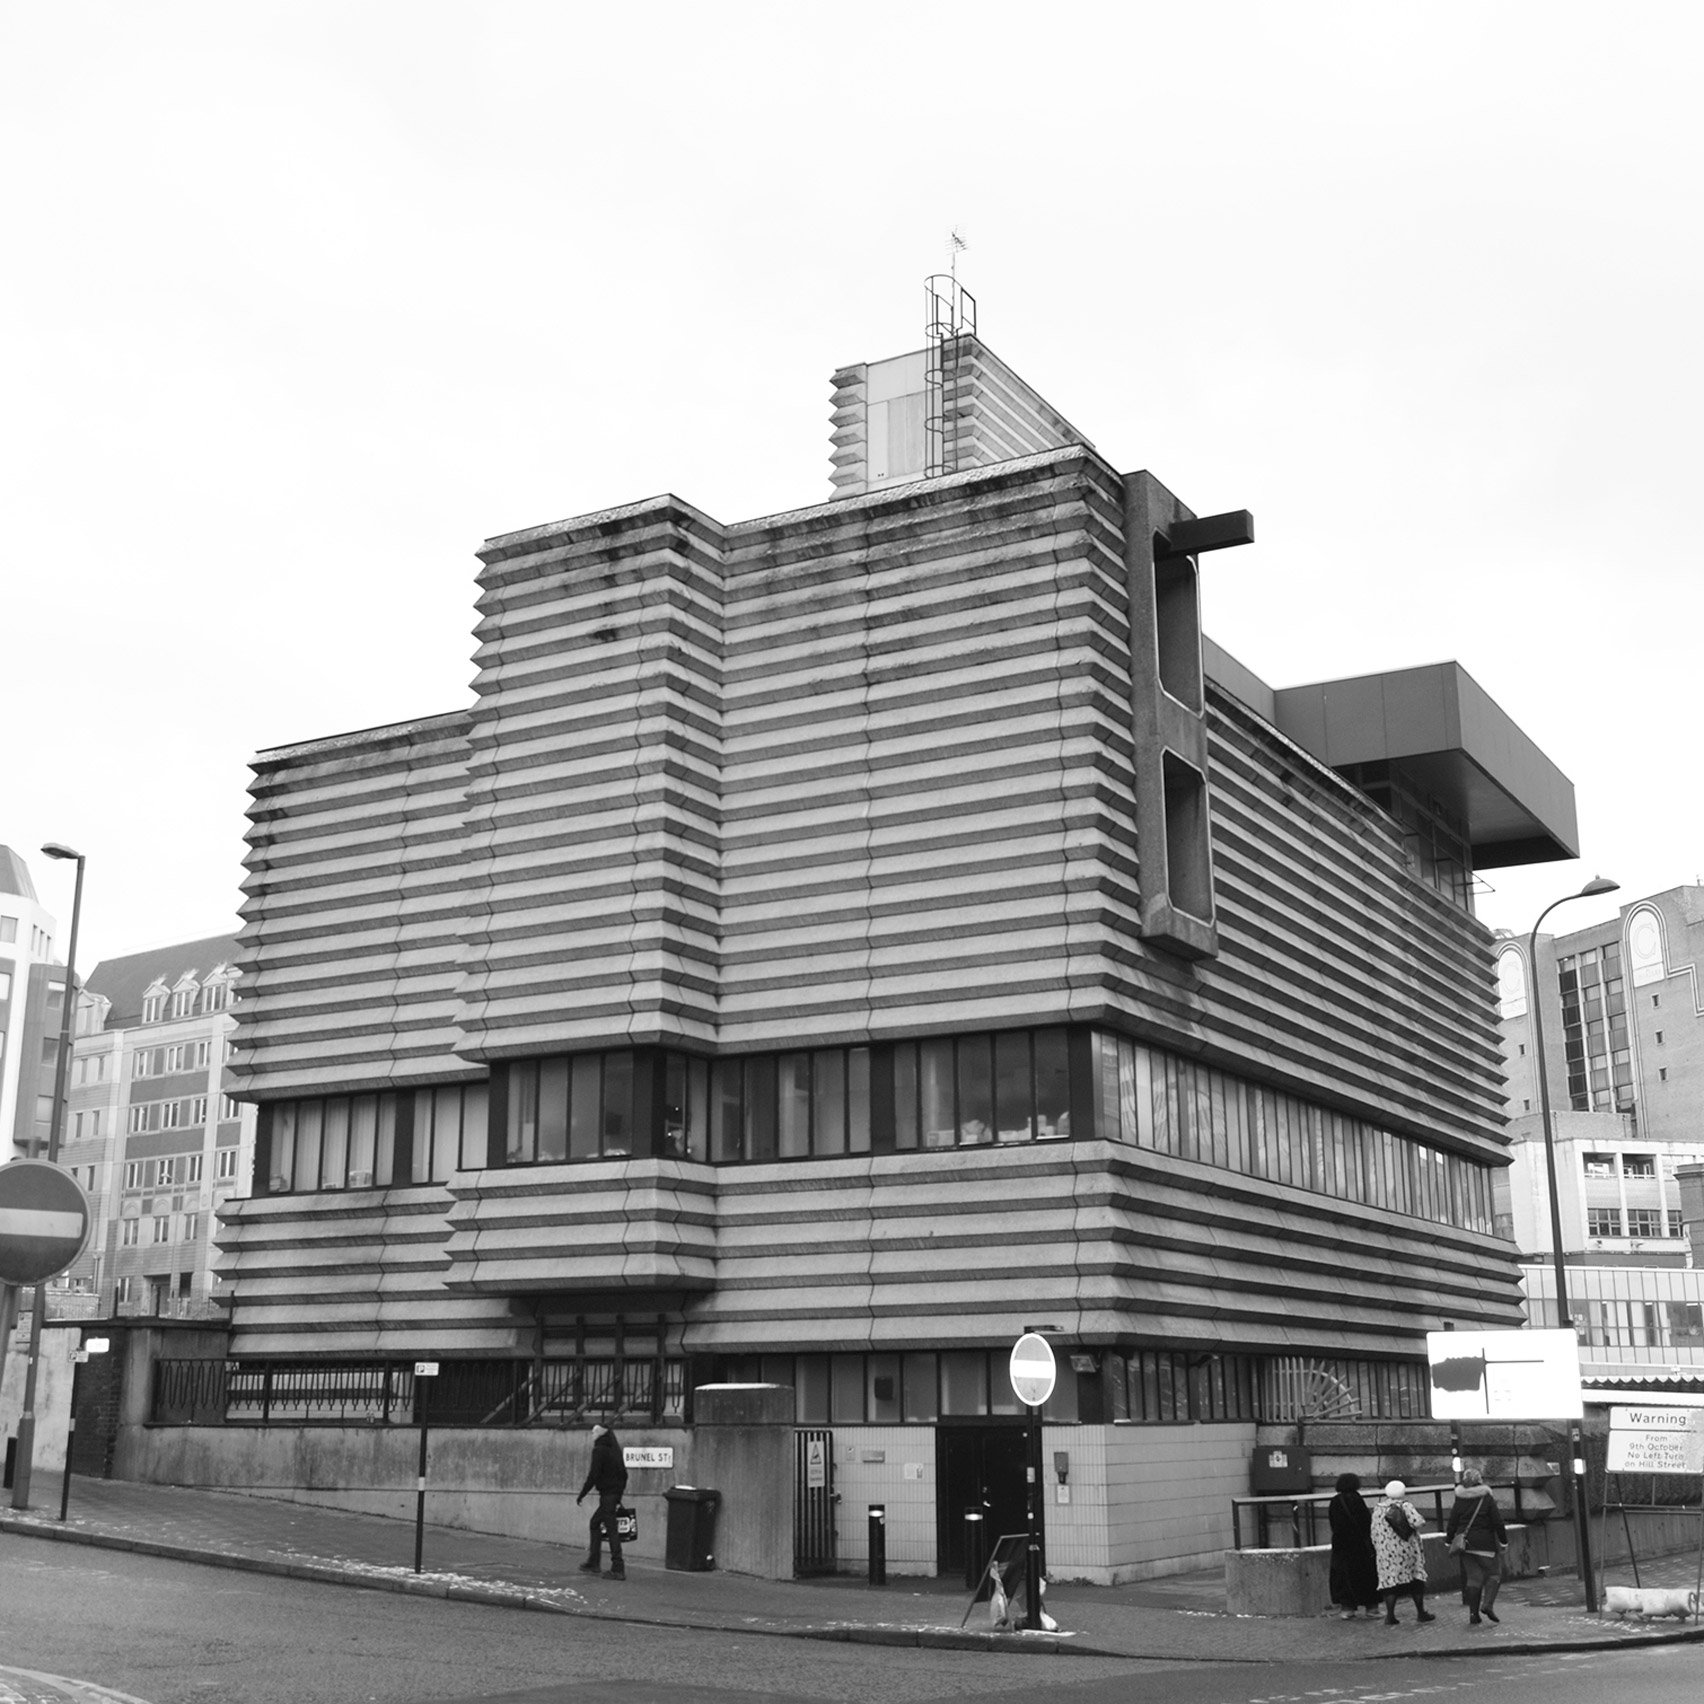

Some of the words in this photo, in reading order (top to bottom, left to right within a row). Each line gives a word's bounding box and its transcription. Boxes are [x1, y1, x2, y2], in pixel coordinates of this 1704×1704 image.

[1629, 1412, 1687, 1426] Warning
[1645, 1434, 1668, 1442] From
[1647, 1443, 1684, 1451] October
[625, 1452, 655, 1462] BRUNEL
[1627, 1451, 1640, 1459] No
[1664, 1452, 1684, 1460] Turn
[1657, 1461, 1686, 1469] Street
